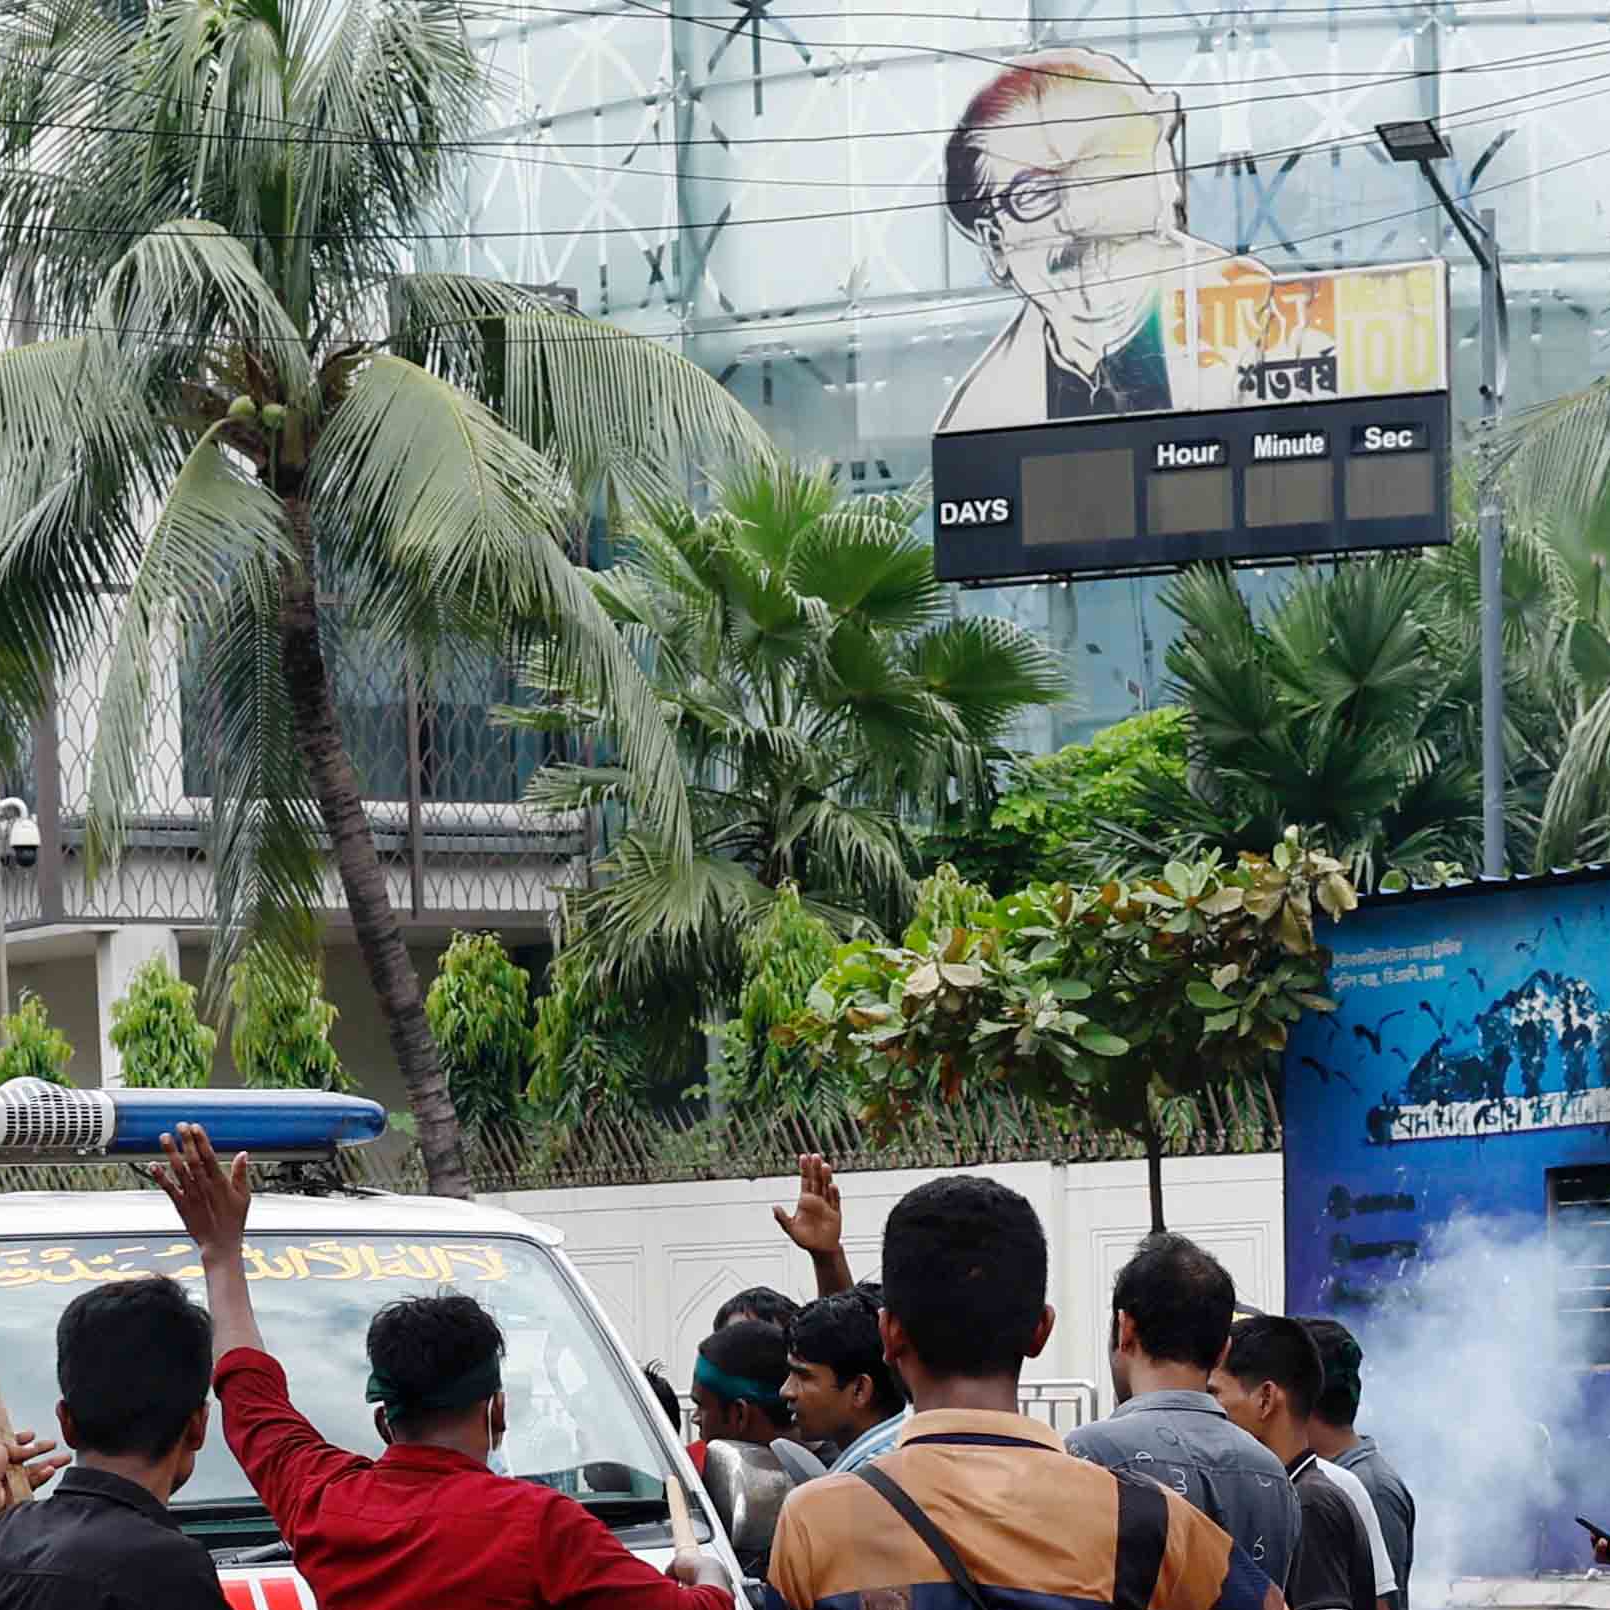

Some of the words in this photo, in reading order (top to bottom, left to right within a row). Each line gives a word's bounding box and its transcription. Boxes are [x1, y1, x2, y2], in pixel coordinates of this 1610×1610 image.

[1157, 443, 1220, 466] Hour
[1254, 434, 1325, 459] Minute
[1365, 427, 1413, 449] Sec
[940, 498, 1009, 526] DAYS
